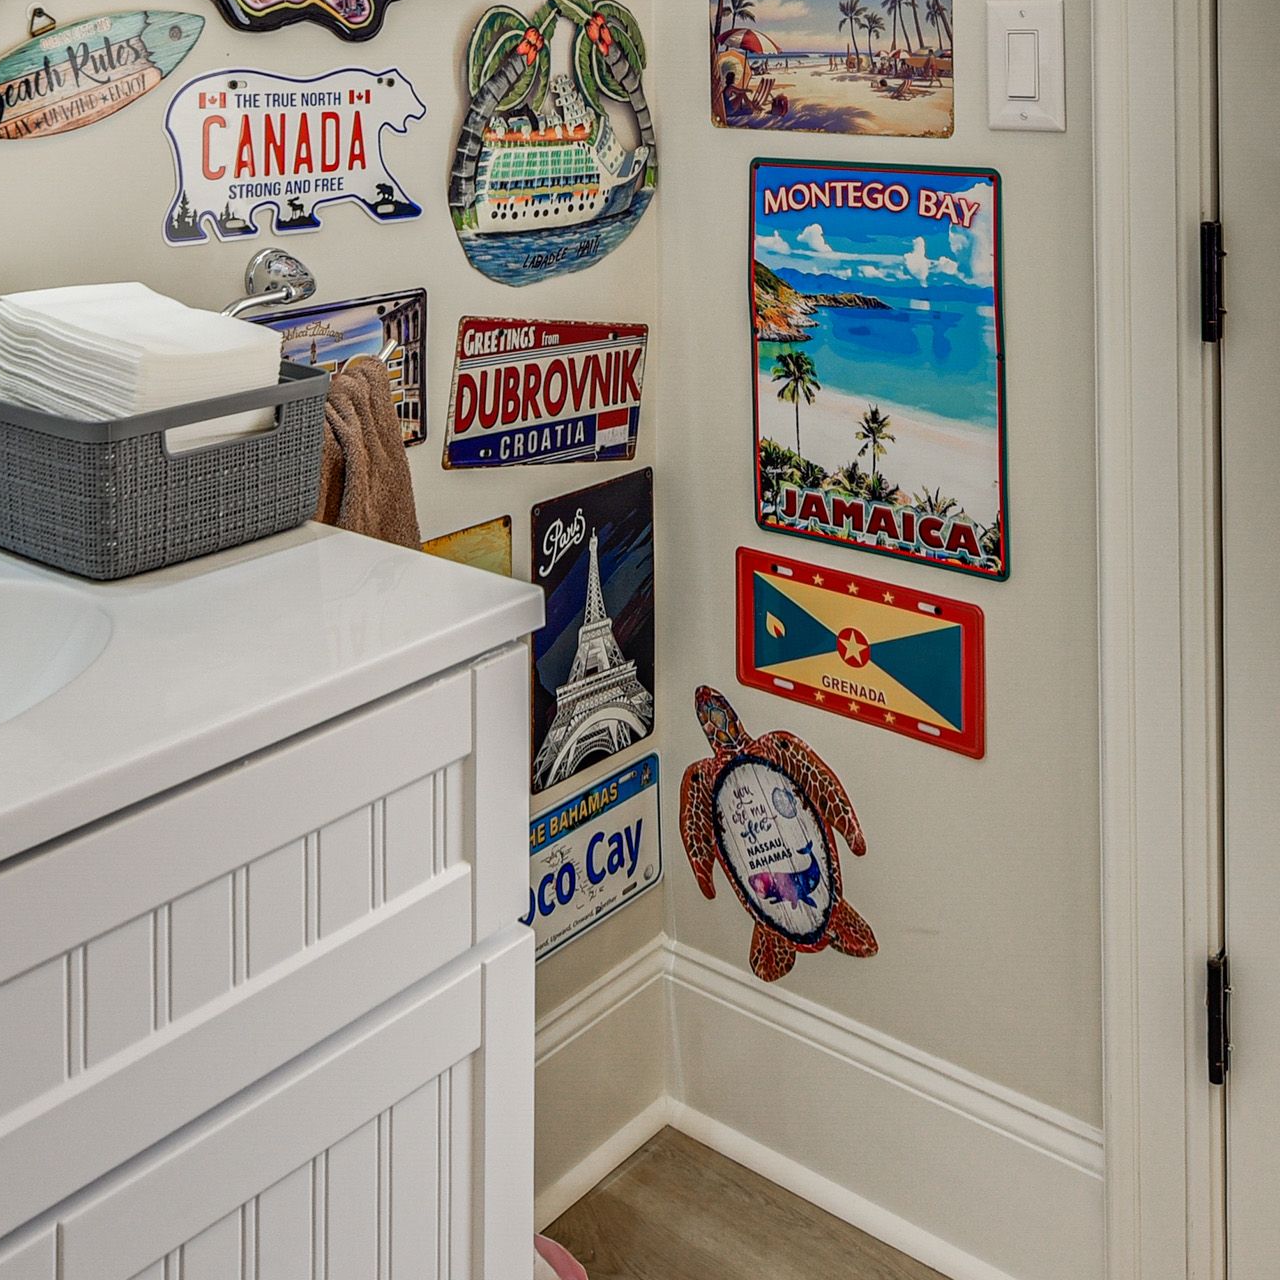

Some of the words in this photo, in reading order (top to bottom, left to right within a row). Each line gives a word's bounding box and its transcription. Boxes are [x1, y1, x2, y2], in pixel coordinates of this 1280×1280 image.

[70, 37, 143, 87] Rules
[41, 92, 99, 127] UNWIND
[109, 73, 148, 105] ENJOY
[235, 93, 261, 109] THE
[265, 93, 297, 108] TRUE
[301, 92, 342, 107] NORTH
[201, 111, 367, 181] CANADA
[228, 180, 282, 201] STRONG
[285, 179, 311, 194] AND
[314, 177, 344, 193] FREE
[763, 181, 910, 216] MONTEGO
[918, 189, 981, 229] BAY
[522, 246, 569, 270] LABADEE
[577, 233, 601, 258] HAITI
[541, 330, 560, 347] from
[454, 347, 643, 435] DUBROVNIK
[499, 420, 586, 461] CROATIA
[539, 508, 586, 577] Paris
[780, 487, 983, 559] JAMAICA
[821, 674, 887, 705] GRENADA
[549, 782, 619, 835] BAHAMAS
[733, 785, 755, 810] you
[586, 817, 644, 886] Cay
[747, 837, 787, 858] NASSAU,
[749, 848, 793, 870] BAHAMAS
